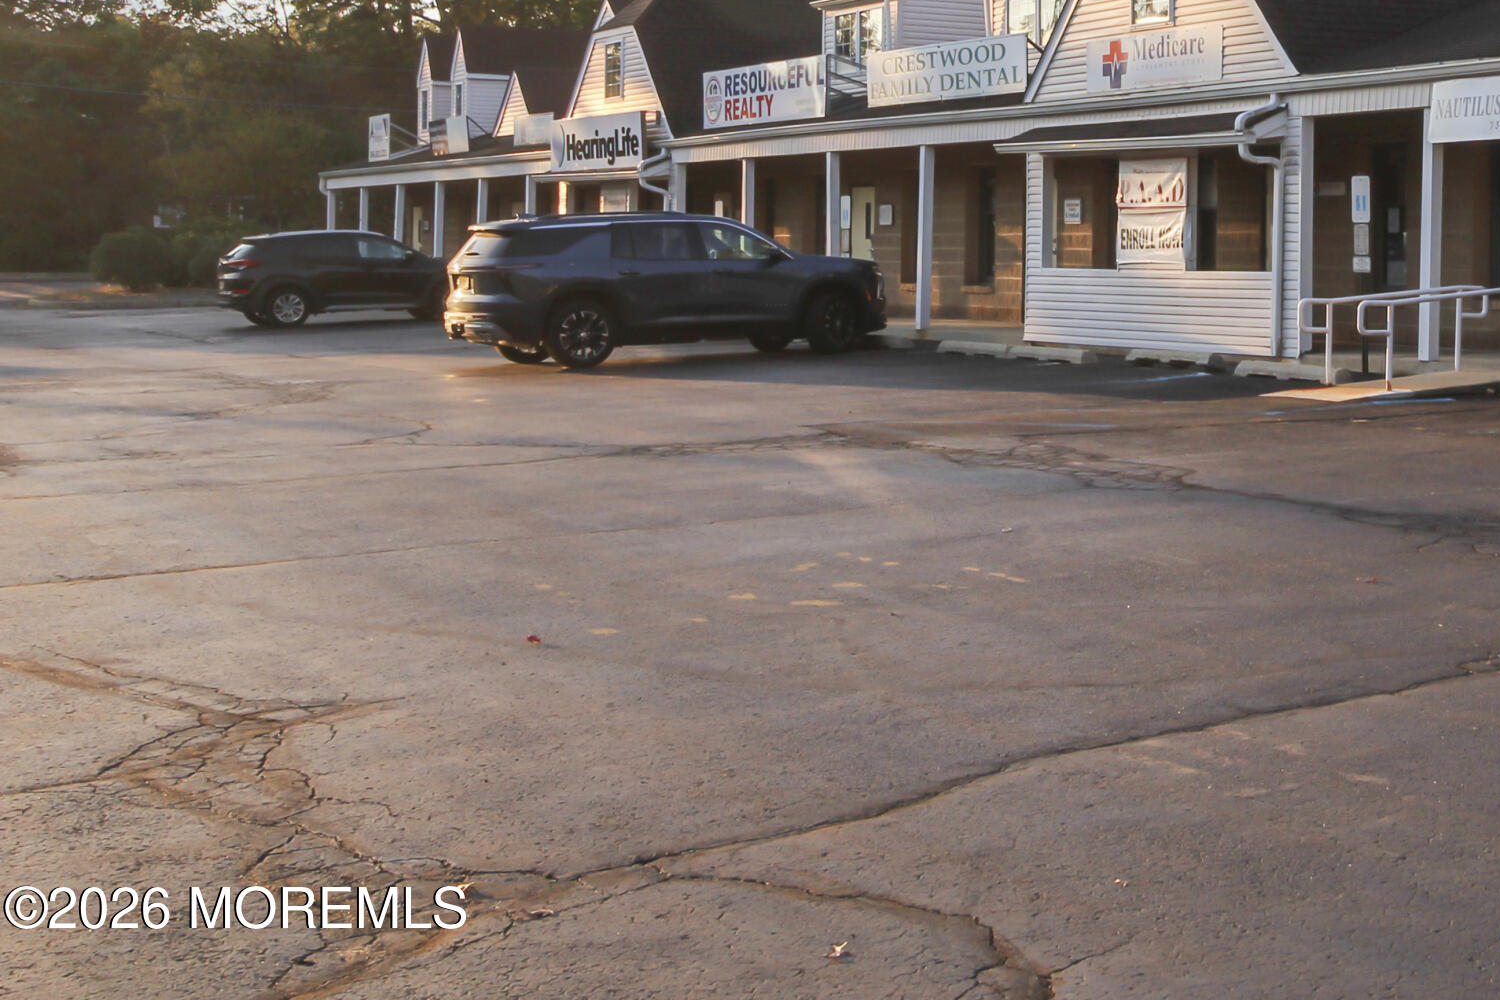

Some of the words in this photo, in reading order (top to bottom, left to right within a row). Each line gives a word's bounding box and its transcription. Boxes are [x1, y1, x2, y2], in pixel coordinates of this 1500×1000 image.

[881, 42, 1007, 76] CRESTWOOD
[1132, 34, 1206, 62] Medicare
[724, 62, 825, 97] RESOURCEFUL
[870, 76, 935, 100] FAMILY
[940, 65, 1024, 92] DENTAL
[724, 94, 774, 121] REALTY
[566, 126, 640, 166] HearingLife
[1120, 226, 1156, 250] ENROLL
